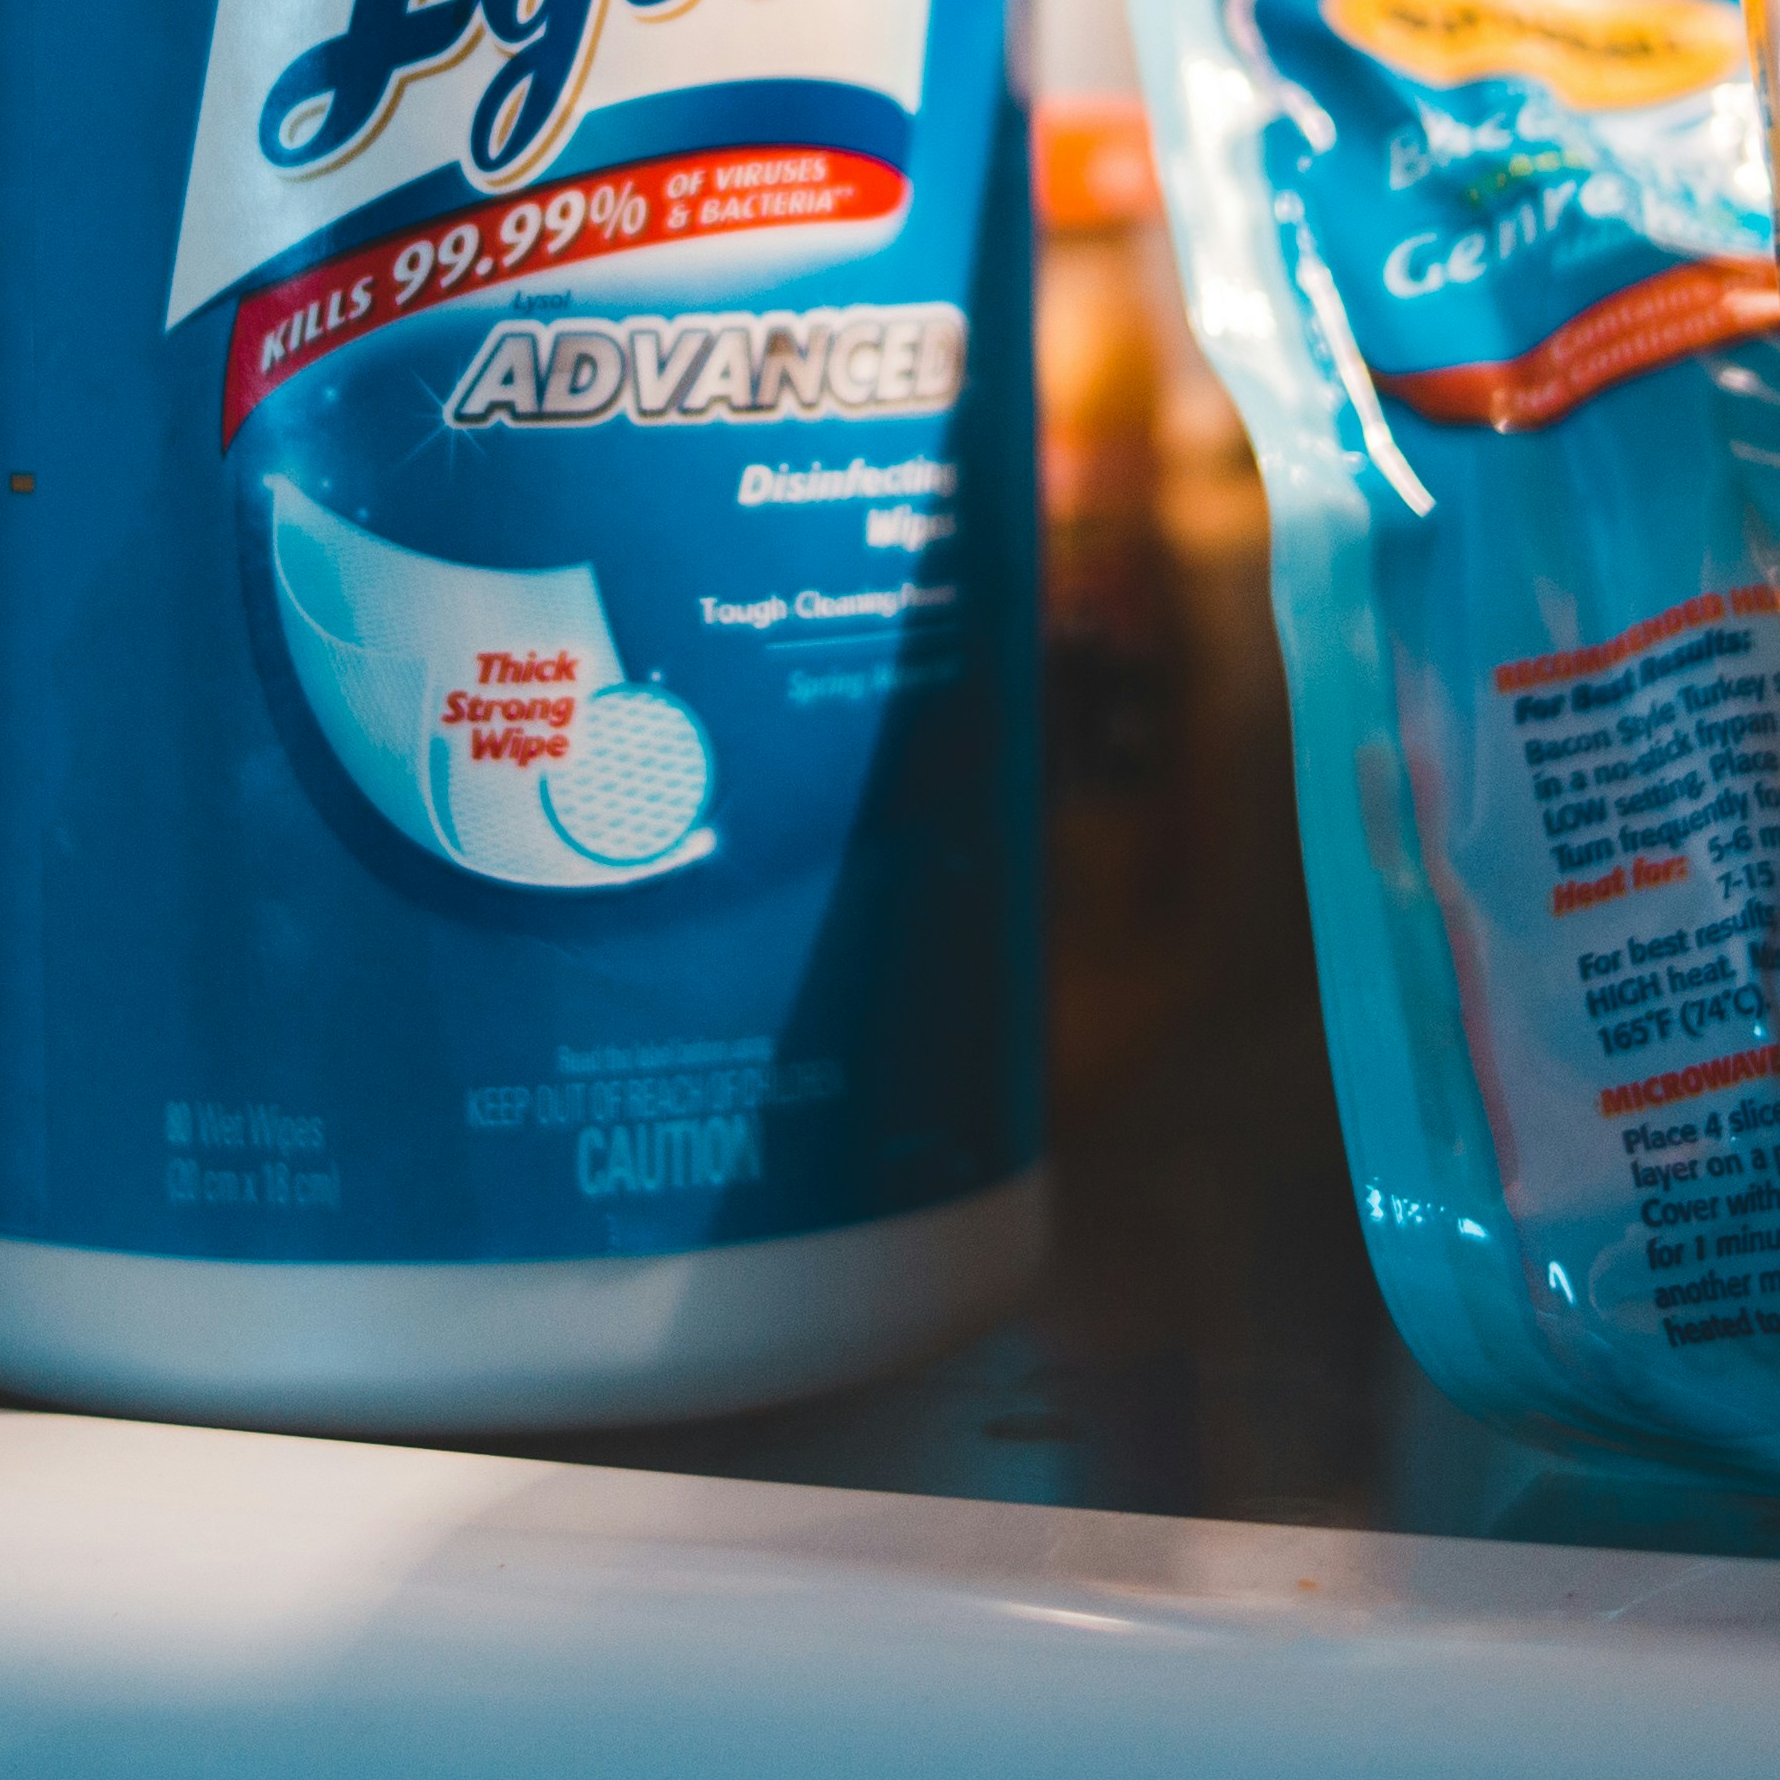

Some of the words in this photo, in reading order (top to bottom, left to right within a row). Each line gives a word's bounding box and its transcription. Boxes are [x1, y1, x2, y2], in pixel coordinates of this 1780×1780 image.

[666, 169, 706, 200] OF
[715, 156, 829, 191] VIRUSES
[666, 202, 691, 229] &
[258, 273, 374, 375] KILLS
[392, 180, 648, 306] 99.99%
[512, 286, 572, 314] Lysol
[452, 306, 966, 426] ADVANCED
[698, 595, 788, 631] Tough
[475, 650, 579, 684] Thick
[442, 690, 576, 726] Strong
[1524, 728, 1612, 768] Bacon
[1677, 672, 1767, 716] Turkey
[470, 729, 569, 767] Wipe
[1532, 772, 1563, 802] in
[1570, 771, 1588, 792] a
[1542, 797, 1609, 838] LOW
[1709, 746, 1778, 783] Place
[1550, 835, 1616, 874] Turn
[1707, 825, 1755, 863] 5-6
[1549, 867, 1626, 918] Heat
[1577, 948, 1623, 983] For
[1627, 932, 1690, 969] best
[1584, 970, 1663, 1020] HIGH
[1622, 1122, 1699, 1156] Place
[1704, 1111, 1724, 1140] 4
[576, 1113, 763, 1197] CAUTION
[1630, 1158, 1700, 1194] layer
[1706, 1153, 1744, 1179] on
[1750, 1147, 1768, 1172] a
[1640, 1195, 1720, 1230] Cover
[1645, 1236, 1686, 1272] for
[1694, 1234, 1707, 1262] 1
[1652, 1270, 1753, 1311] another
[1663, 1306, 1755, 1349] heated
